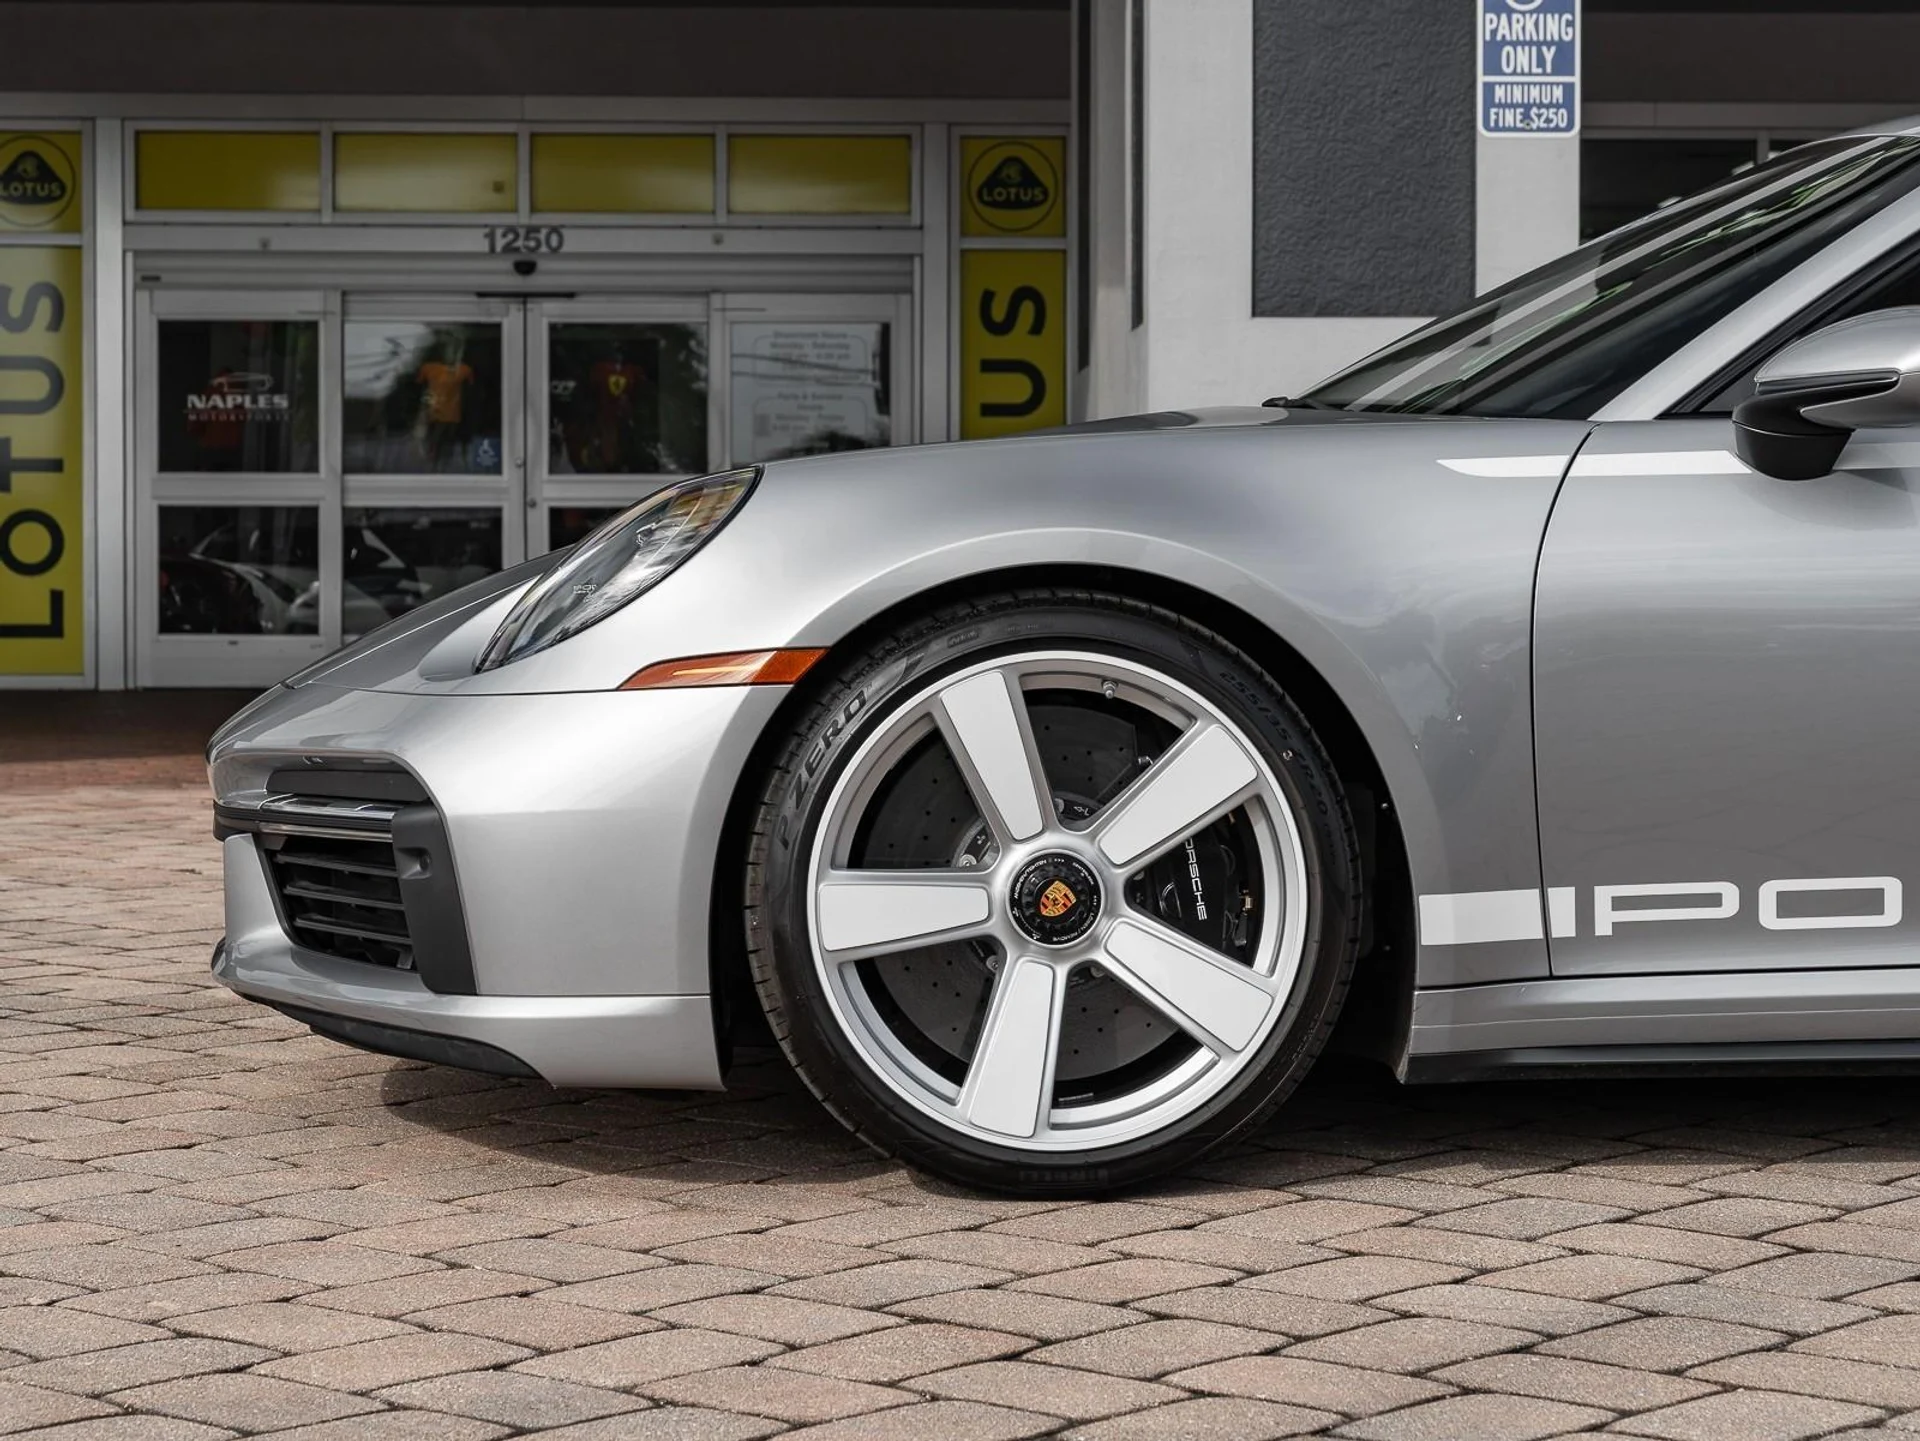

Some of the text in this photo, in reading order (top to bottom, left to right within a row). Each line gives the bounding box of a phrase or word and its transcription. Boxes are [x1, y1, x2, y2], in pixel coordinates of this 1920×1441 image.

[1484, 12, 1573, 42] PARKING
[1501, 45, 1557, 74] ONLY
[1494, 84, 1564, 104] MINIMUM
[1489, 106, 1568, 129] FINE $250
[0, 181, 61, 197] LOTUS
[982, 187, 1045, 202] LOTUS
[483, 226, 564, 253] 1250
[186, 393, 289, 409] NAPLES
[0, 281, 65, 638] LOTUS
[777, 690, 867, 850] P ZERO
[1184, 837, 1208, 921] ORSCHE
[1594, 876, 1903, 936] PO
